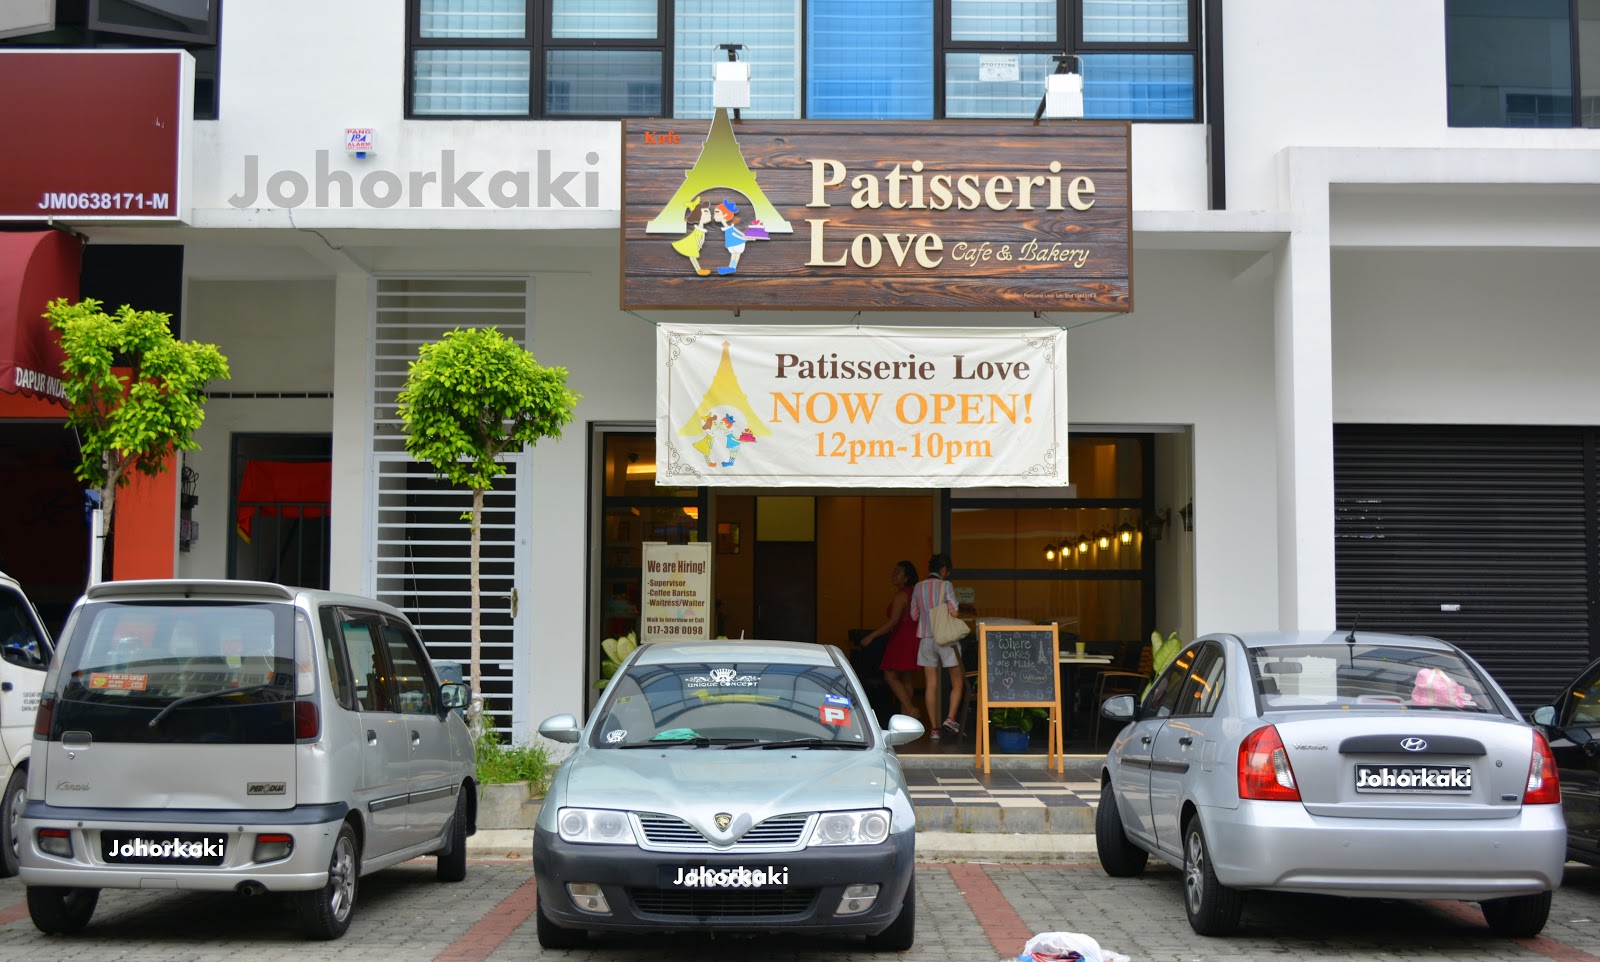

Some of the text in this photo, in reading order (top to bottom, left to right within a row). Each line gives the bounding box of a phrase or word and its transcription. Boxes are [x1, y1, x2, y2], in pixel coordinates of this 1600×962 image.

[645, 131, 681, 144] Kafe
[805, 158, 1096, 211] Patisserie
[38, 192, 169, 210] JM0638171-M
[804, 218, 944, 269] Love
[951, 238, 1090, 269] Cafe & Bakery
[774, 353, 1030, 381] Patisserie Love
[15, 366, 70, 400] DAPUR INDA
[769, 391, 1033, 425] NOW OPEN!
[814, 431, 993, 464] 12pm-10pm
[647, 560, 706, 575] We are Hiring!
[647, 580, 686, 588] -Supervisor
[647, 589, 671, 597] -Coffee
[647, 599, 705, 607] -Waitress/Waiter
[647, 626, 703, 635] 017-338 0098
[998, 637, 1032, 650] Where
[824, 707, 845, 723] P
[249, 783, 284, 793] PERODUA
